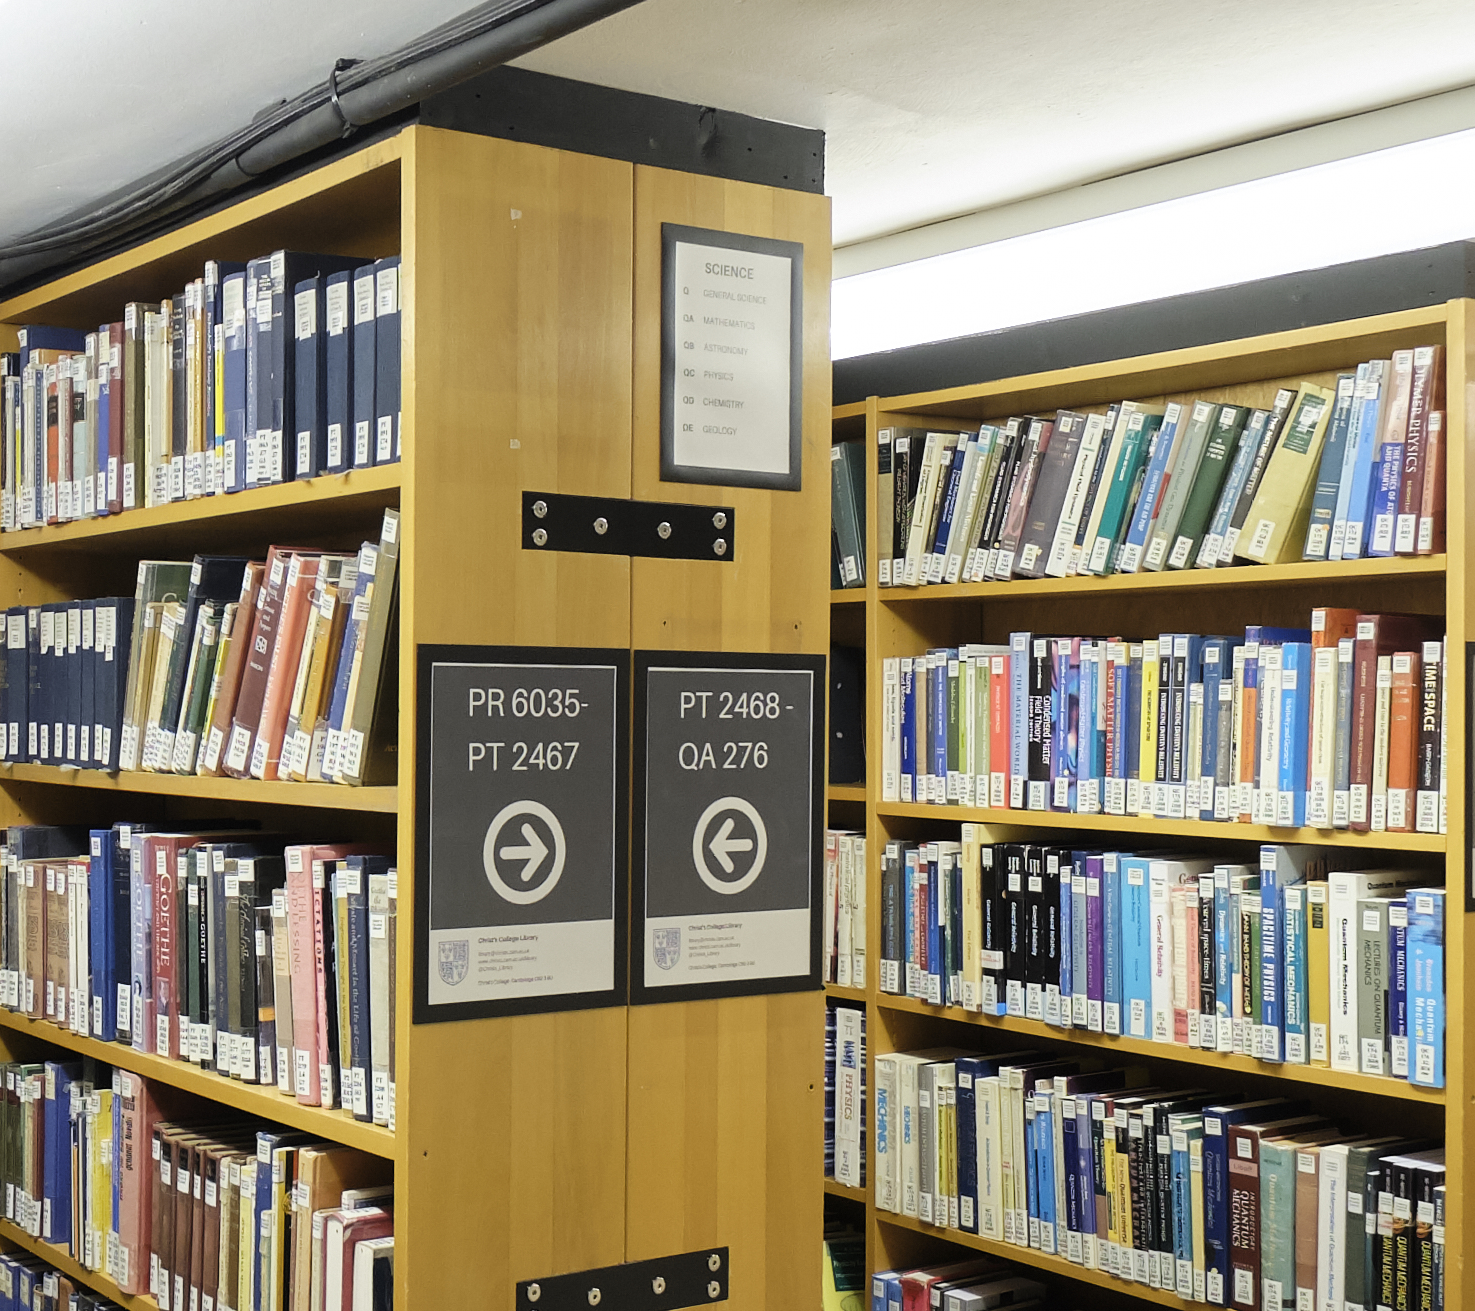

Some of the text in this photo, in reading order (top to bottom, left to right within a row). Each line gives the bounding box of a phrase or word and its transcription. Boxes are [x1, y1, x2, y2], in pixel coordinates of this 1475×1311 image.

[705, 262, 754, 280] SCIENCE
[683, 287, 689, 295] Q
[704, 289, 767, 305] GENERAL SCIENCE
[683, 314, 694, 323] QA
[704, 316, 755, 330] MATHEMATICS
[704, 343, 748, 356] ASTRONOMY
[683, 369, 695, 377] QC
[704, 370, 734, 381] PHYSICS
[703, 398, 744, 409] CHEMISTRY
[703, 425, 737, 436] GEOLOGY
[469, 688, 589, 717] PR 6035-
[680, 692, 713, 718] PT
[719, 692, 780, 719] 2468
[1423, 693, 1436, 732] SPACE
[468, 742, 580, 771] PT 2467
[678, 742, 769, 771] QA 276
[159, 873, 172, 967] GOETHE
[1155, 943, 1163, 979] Relativity
[1262, 907, 1275, 1002] SPACETIME PHYSICS
[1232, 1188, 1240, 1247] MECHANICS
[1241, 1191, 1249, 1249] QUANTUM
